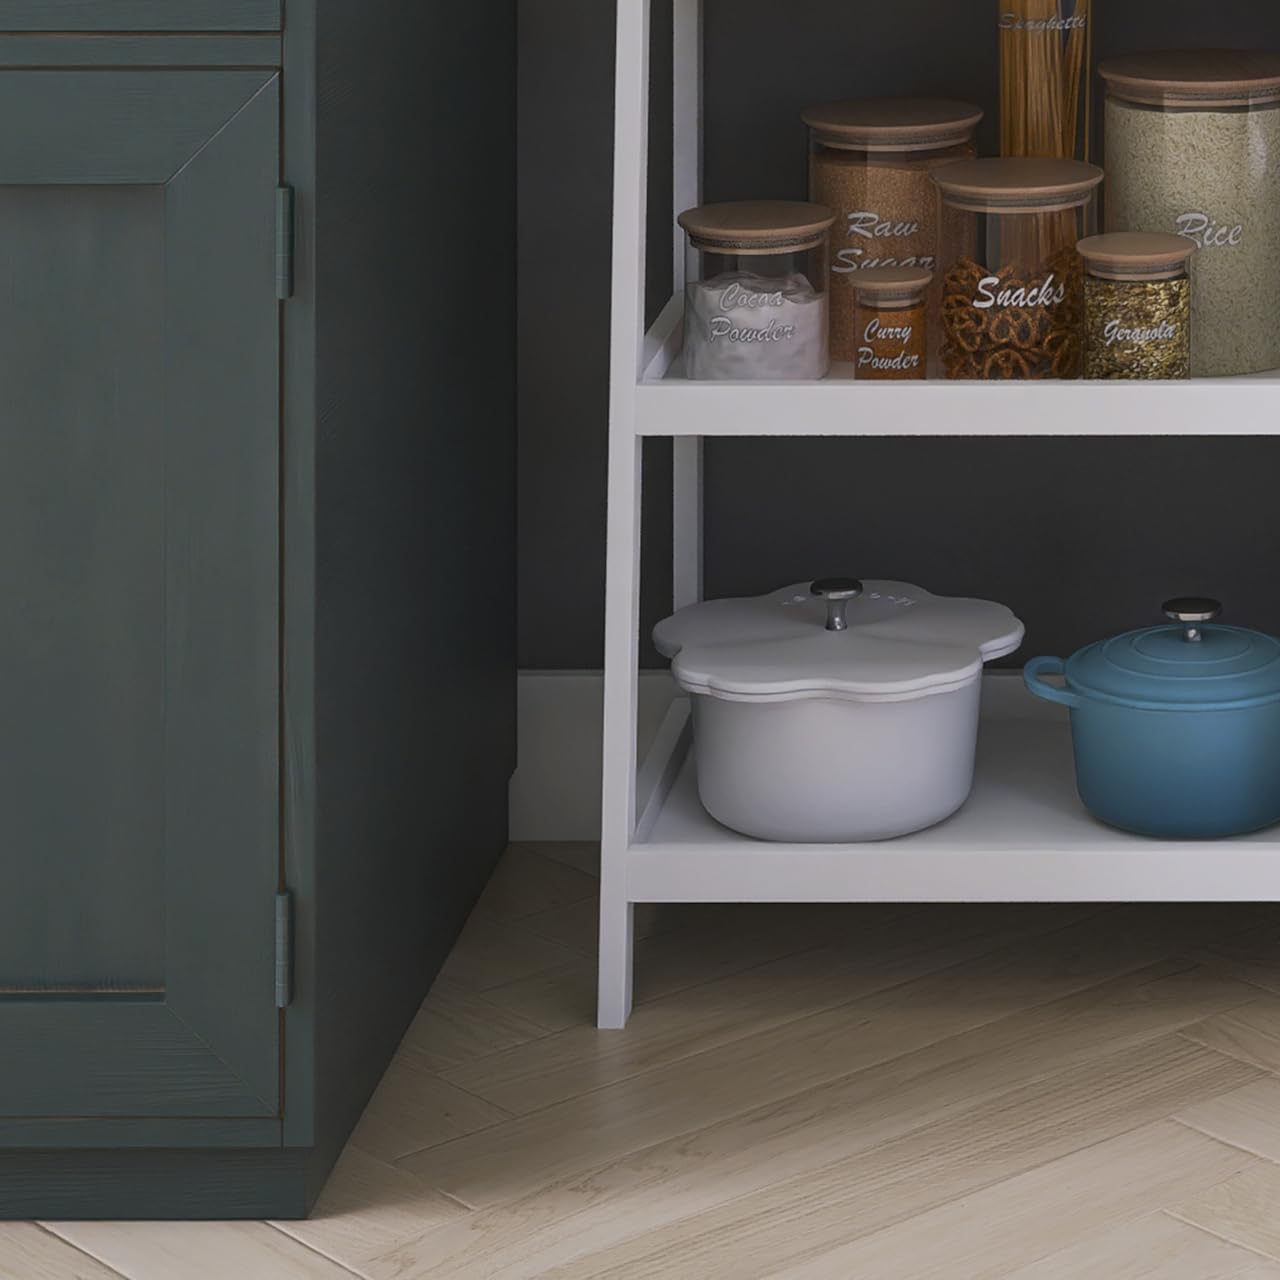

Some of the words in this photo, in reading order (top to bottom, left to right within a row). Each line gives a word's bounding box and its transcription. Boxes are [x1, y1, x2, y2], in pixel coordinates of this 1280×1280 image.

[847, 211, 919, 239] Raw
[1175, 213, 1243, 248] Rice
[719, 282, 785, 313] Cocoa
[972, 273, 1065, 309] Snacks
[709, 316, 796, 344] Powder
[863, 318, 913, 345] Curry
[1103, 320, 1177, 346] Geranola
[857, 346, 920, 370] Powder
